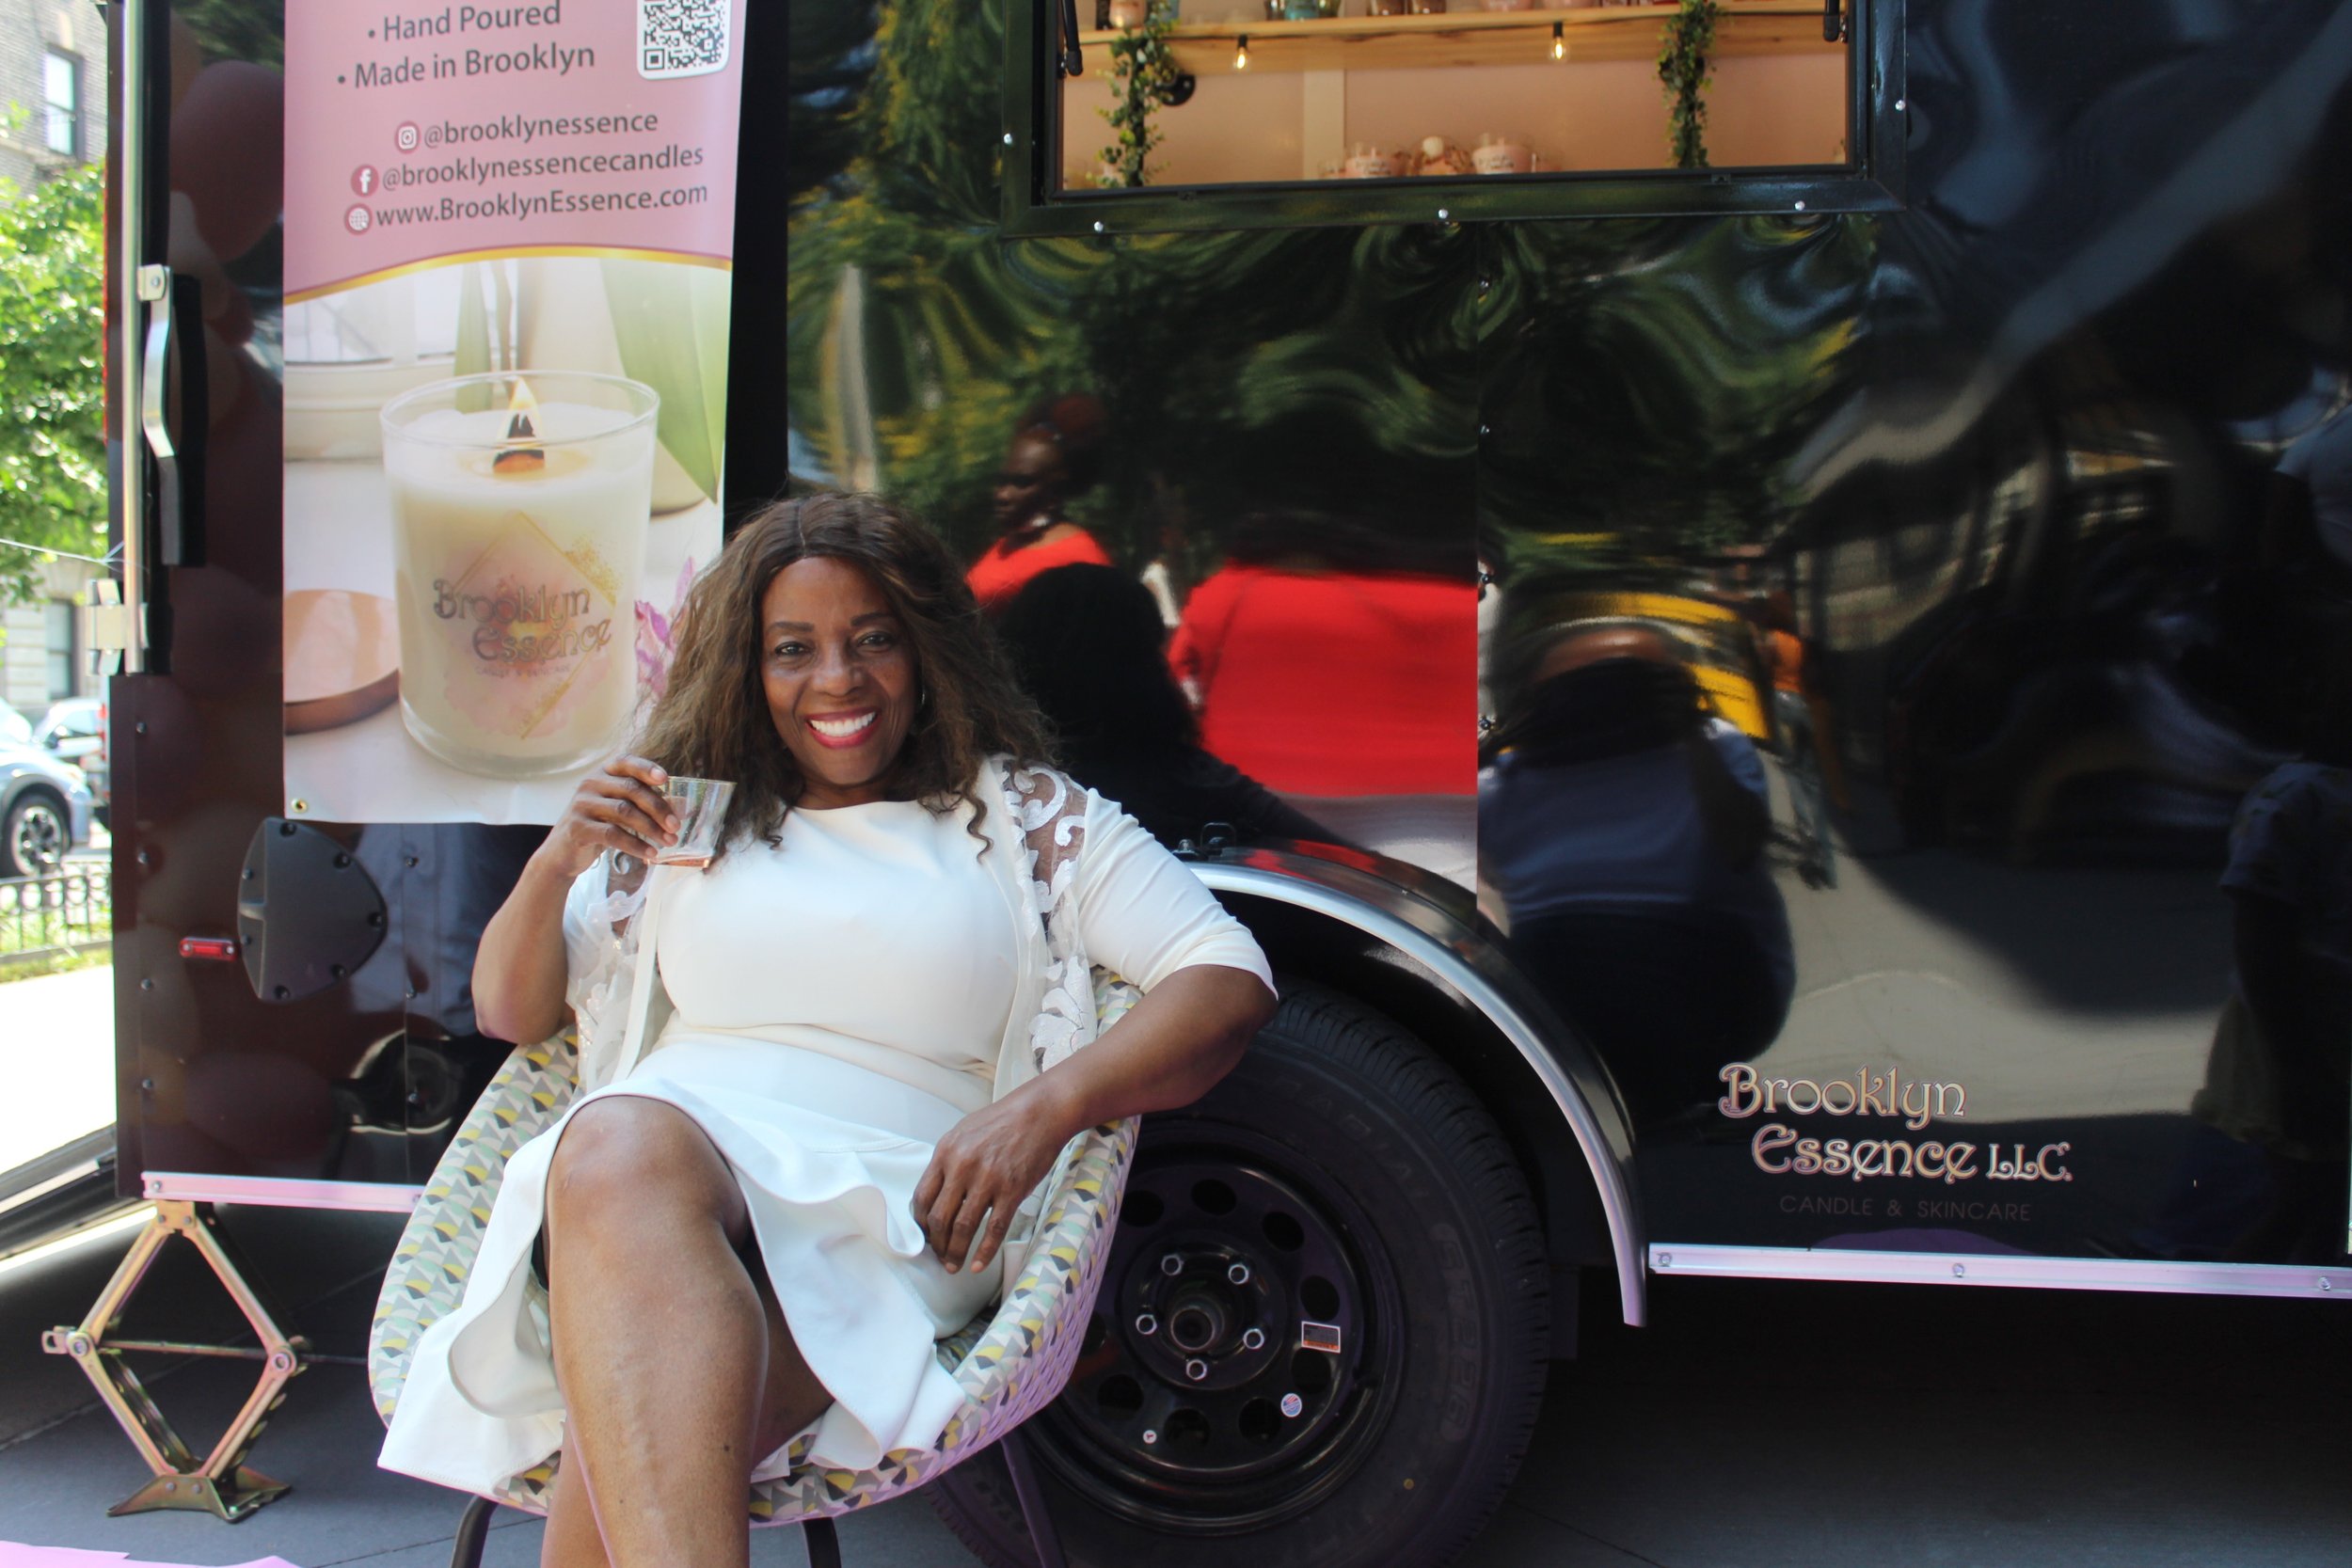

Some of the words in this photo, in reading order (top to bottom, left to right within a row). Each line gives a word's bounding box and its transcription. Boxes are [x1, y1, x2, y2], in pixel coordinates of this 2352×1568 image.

[382, 8, 452, 41] Hand
[459, 0, 562, 32] Poured
[354, 56, 425, 89] Made
[432, 54, 457, 79] in
[464, 41, 596, 76] Brooklyn
[423, 113, 659, 150] @brooklynessence
[382, 144, 705, 192] @brooklynessencecandles
[375, 184, 707, 227] www.BrooklynEssence.com
[432, 578, 591, 630] Brooklyn
[472, 618, 612, 664] Essence
[1717, 1061, 1967, 1131] Brooklyn
[1750, 1122, 1978, 1185] Essence
[1779, 1195, 1874, 1216] CANDLE
[1885, 1198, 1904, 1218] &
[1916, 1199, 2032, 1222] SKINCARE
